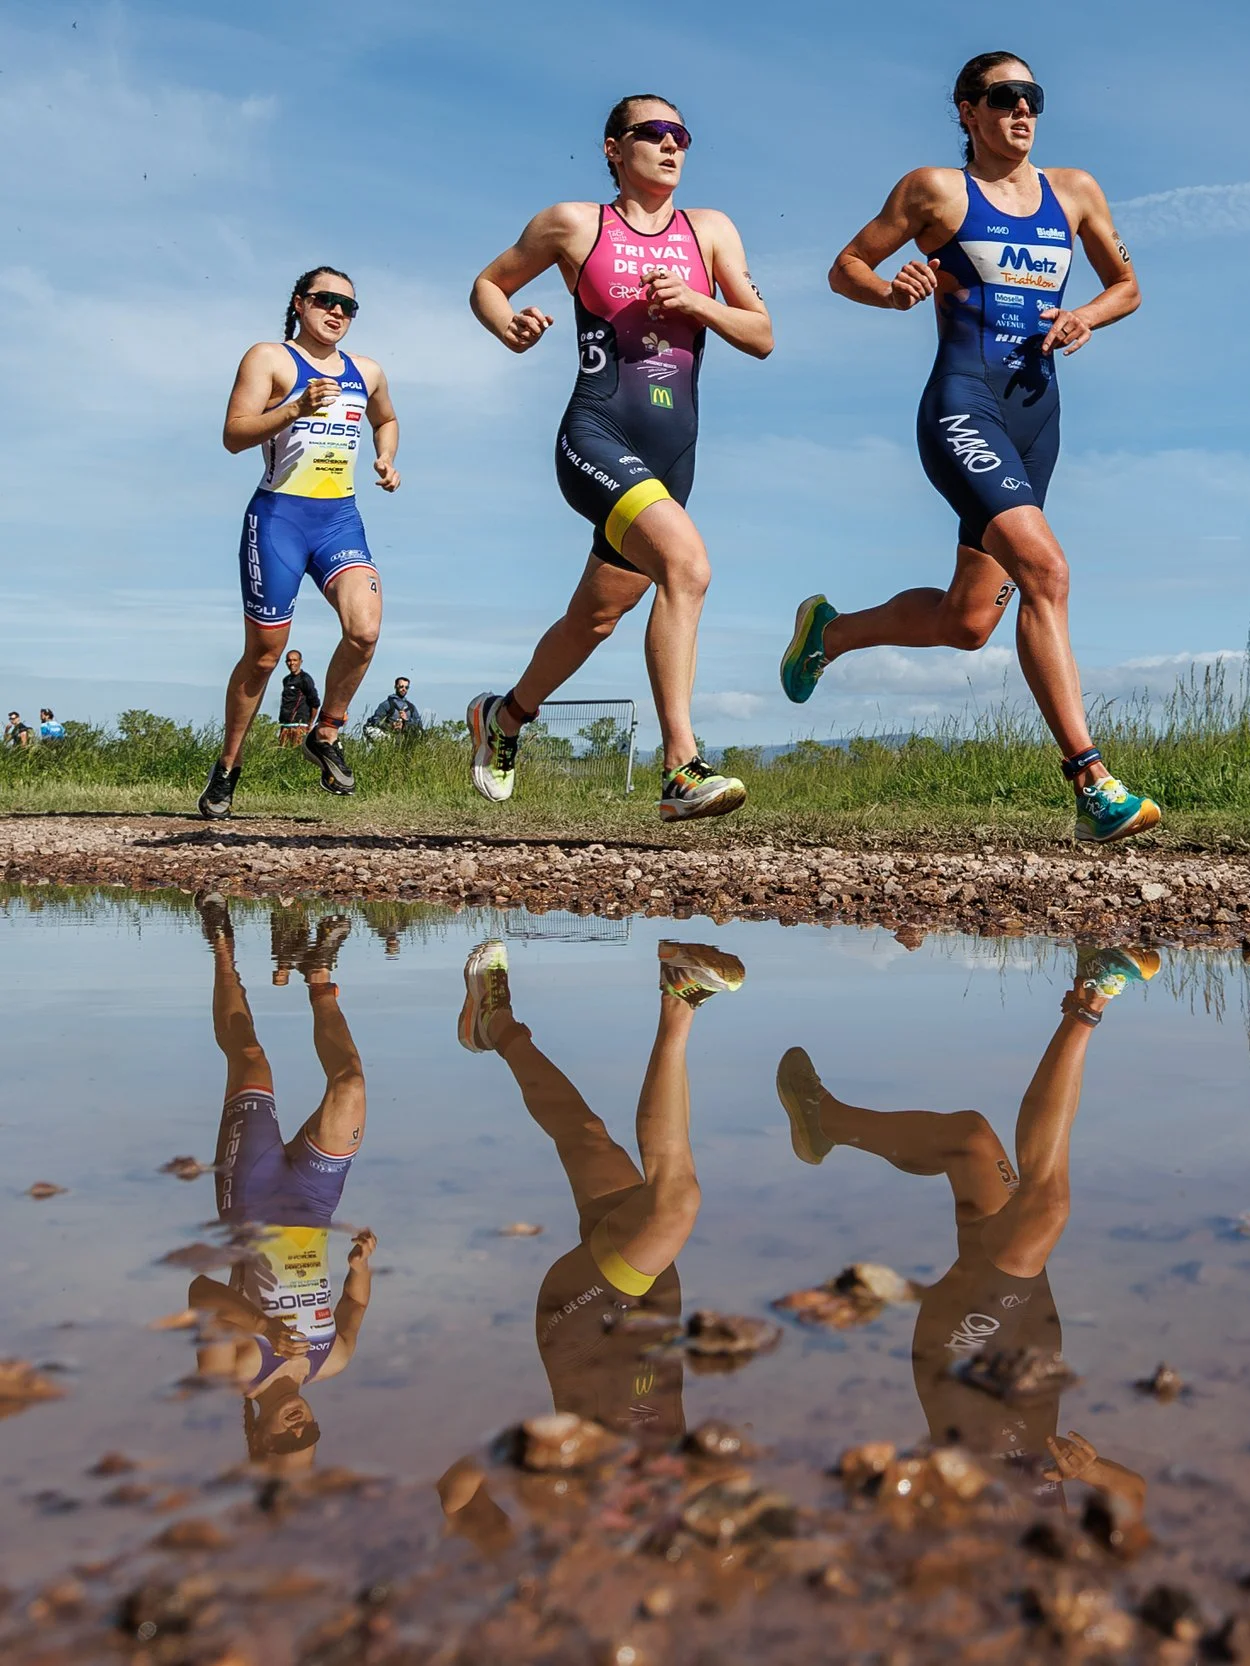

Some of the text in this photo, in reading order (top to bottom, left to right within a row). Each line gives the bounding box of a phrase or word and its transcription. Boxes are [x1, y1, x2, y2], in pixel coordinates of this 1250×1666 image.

[613, 243, 689, 260] TRI VAL
[997, 245, 1057, 274] Metz
[614, 259, 638, 275] DE
[1000, 272, 1056, 288] Triathlon
[609, 285, 643, 299] GRAY
[996, 293, 1023, 304] Moselle
[996, 320, 1026, 329] AVENUE
[1001, 313, 1019, 321] CAR
[939, 414, 1002, 473] MAKO
[566, 449, 581, 467] VAL
[581, 463, 597, 475] DE
[594, 471, 621, 491] GRAY
[248, 513, 264, 598] POISSY
